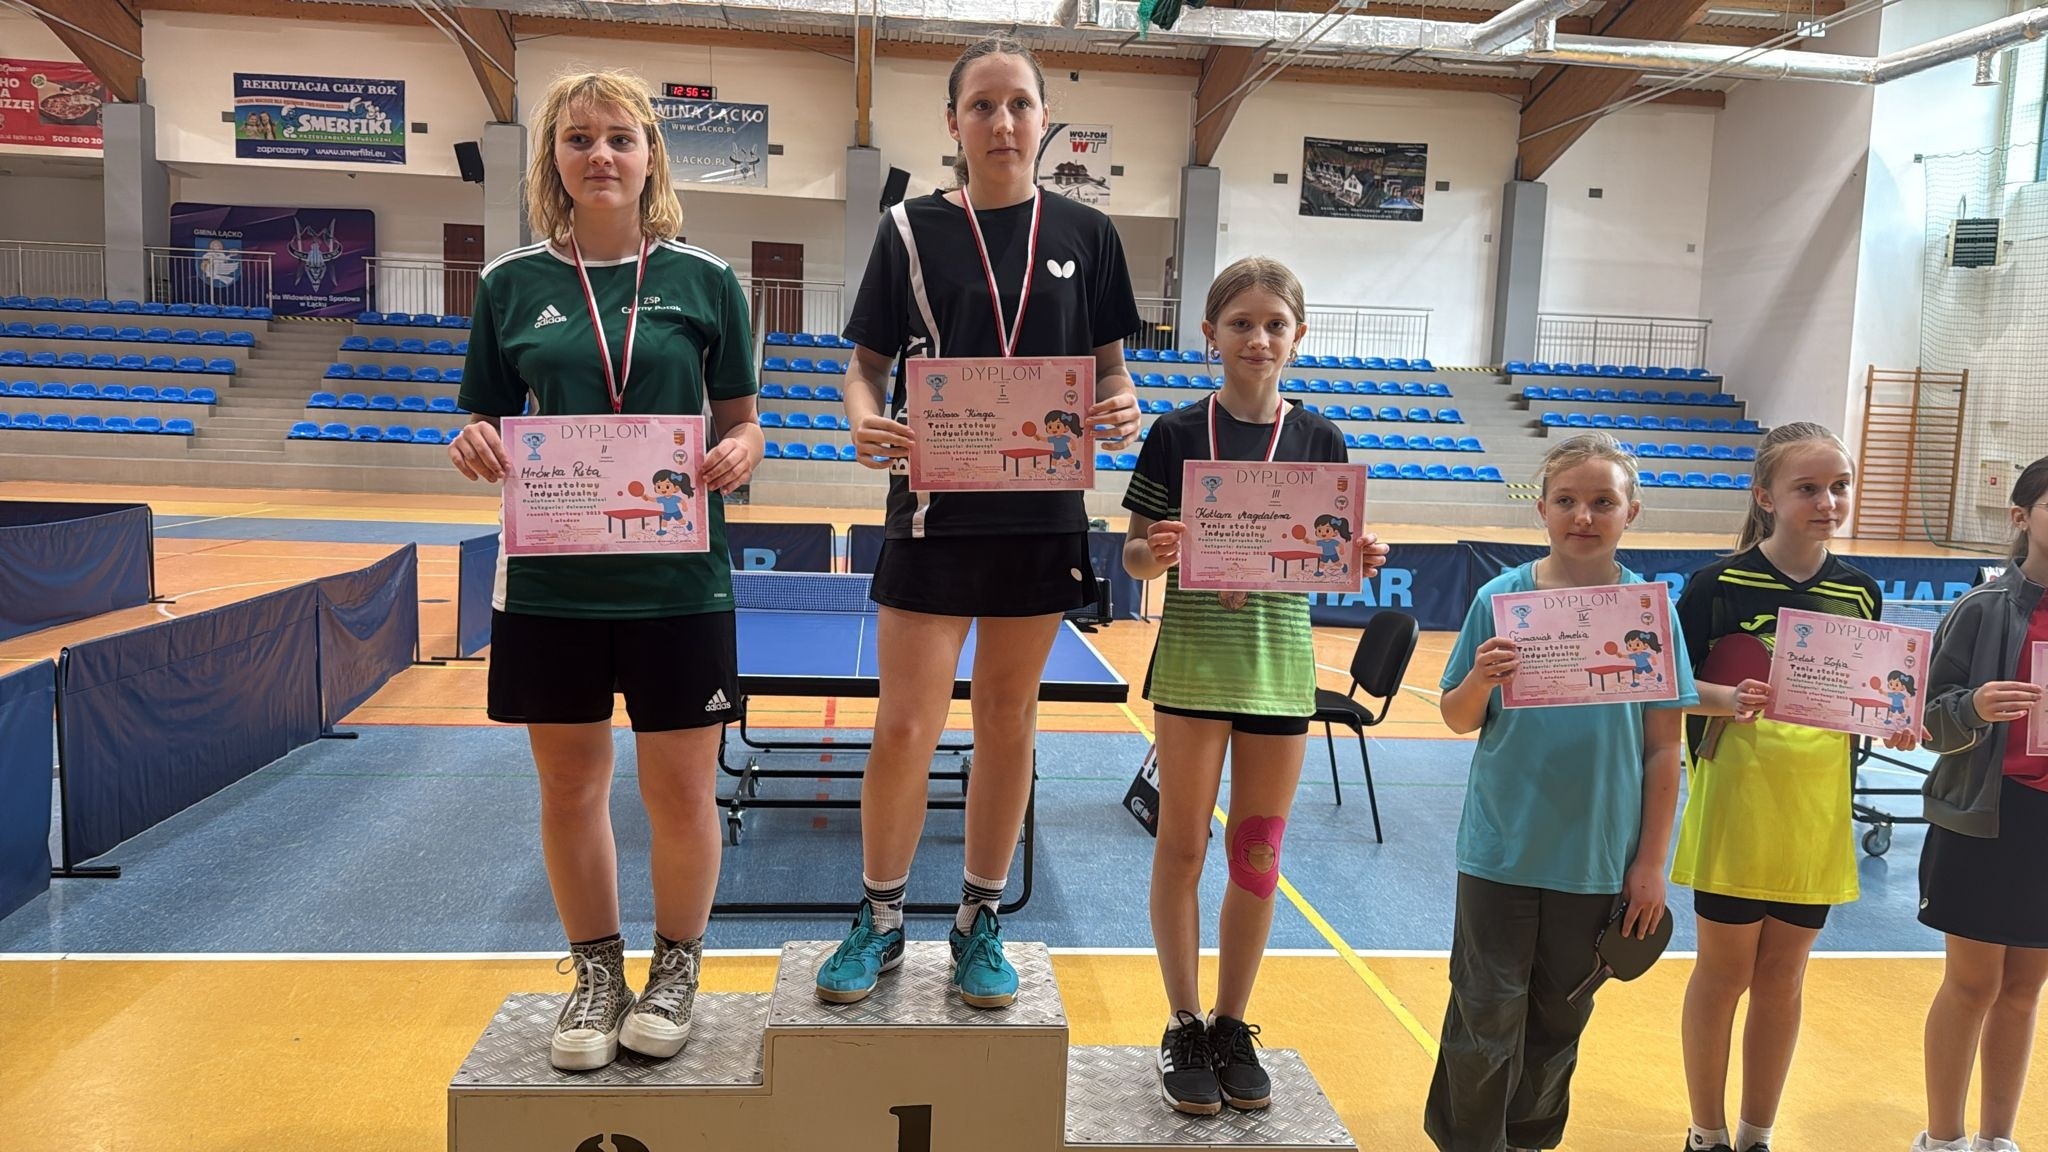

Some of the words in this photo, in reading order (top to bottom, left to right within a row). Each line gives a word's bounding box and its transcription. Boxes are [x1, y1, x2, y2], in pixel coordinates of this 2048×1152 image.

[0, 78, 20, 88] HO
[242, 79, 330, 93] REKRUTACJA
[333, 84, 365, 94] CAŁY
[367, 85, 398, 96] ROK
[1, 88, 11, 98] A
[0, 99, 35, 112] IZZĘ!
[652, 103, 702, 119] MINA
[297, 114, 392, 135] SMERFIKI
[1069, 130, 1108, 139] WOJ-TOM
[256, 145, 310, 156] zapraszamy
[315, 148, 386, 158] www.smerfiki.eu
[193, 228, 217, 237] GMINA
[218, 230, 243, 239] ŁĄCKO
[643, 296, 661, 305] ZSP
[621, 305, 653, 314] Czrny
[534, 315, 568, 329] adidas
[962, 366, 1041, 381] DYPLOM
[965, 408, 996, 422] Kinga
[561, 424, 648, 440] DYPLOM
[573, 461, 602, 478] Rita
[1236, 470, 1314, 485] DYPLOM
[530, 490, 599, 498] indywidualny
[1237, 510, 1292, 524] Magdalena
[1229, 523, 1267, 531] stołowy
[1204, 530, 1265, 538] indywidualny
[1543, 593, 1618, 610] DYPLOM
[1558, 630, 1590, 640] Amelia
[1825, 621, 1890, 643] DYPLOM
[1823, 656, 1849, 671] Zofia
[705, 701, 731, 712] adidas
